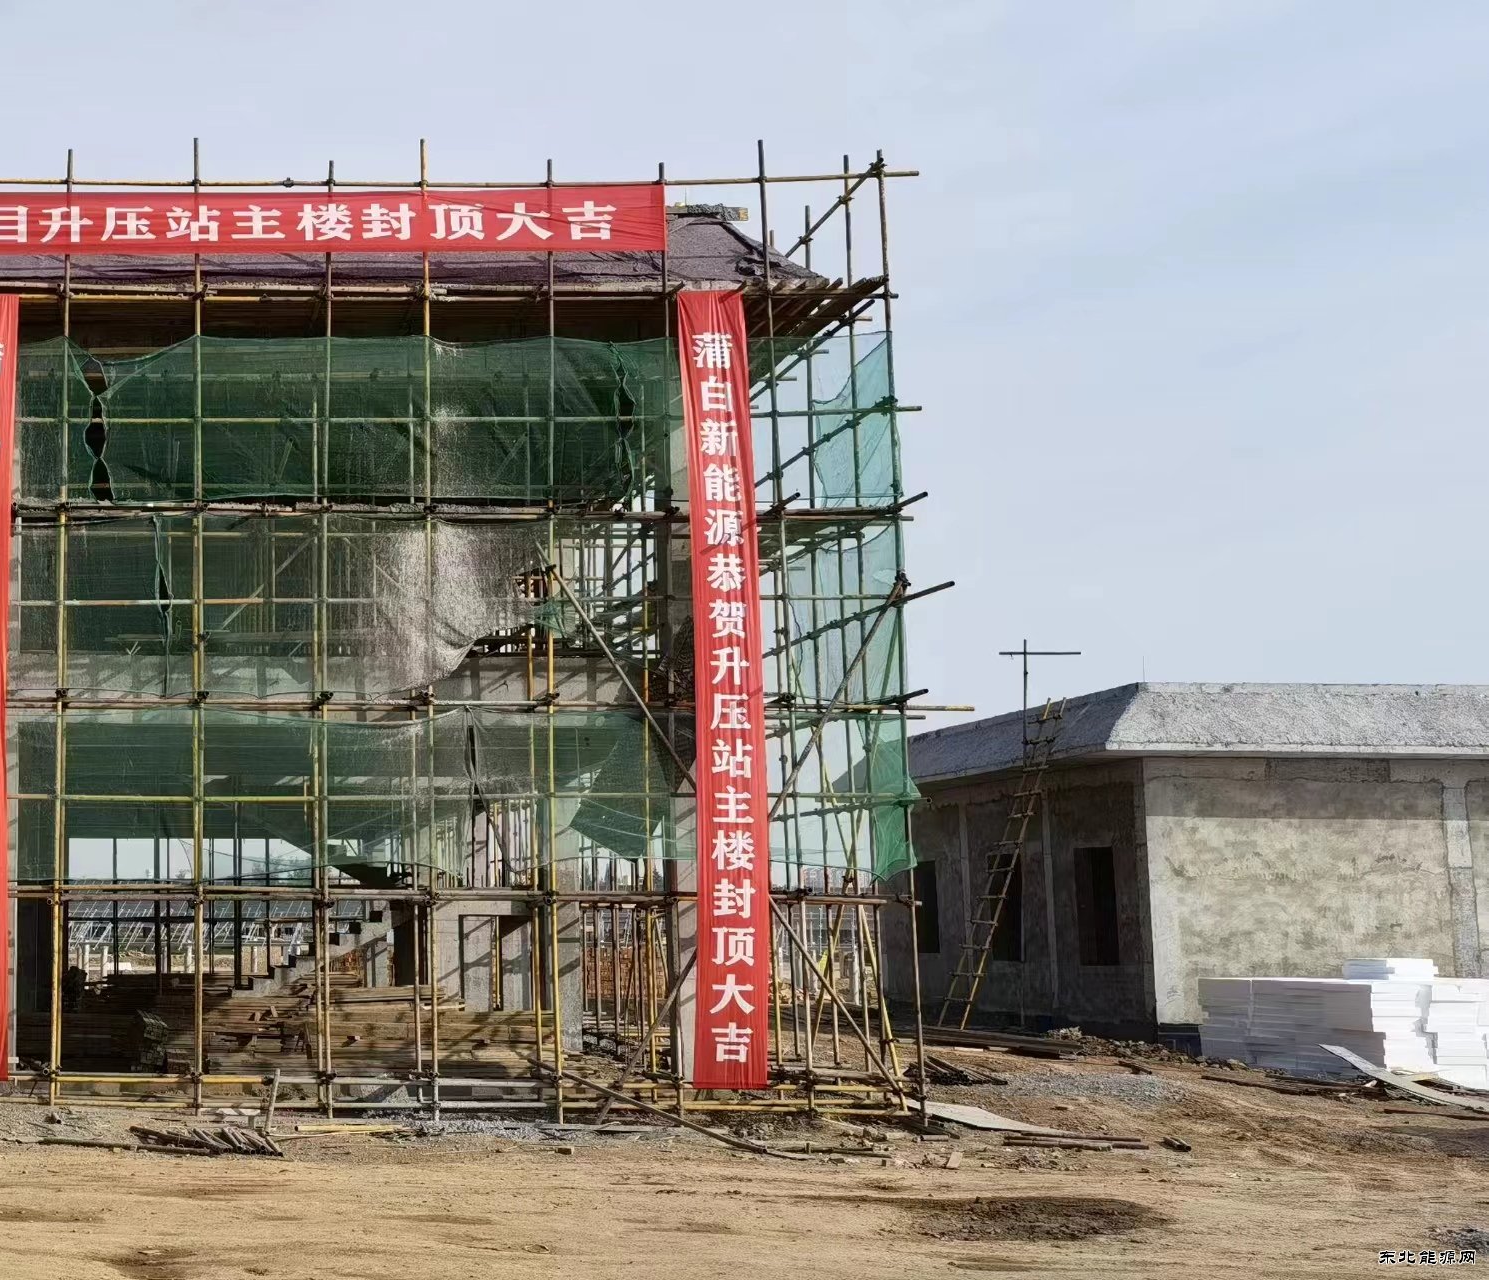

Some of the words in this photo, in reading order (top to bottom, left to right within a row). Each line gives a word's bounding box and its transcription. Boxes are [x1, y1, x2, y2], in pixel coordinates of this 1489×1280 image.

[692, 332, 756, 1063] 蒲白新能源恭贺升压站主楼封顶大吉
